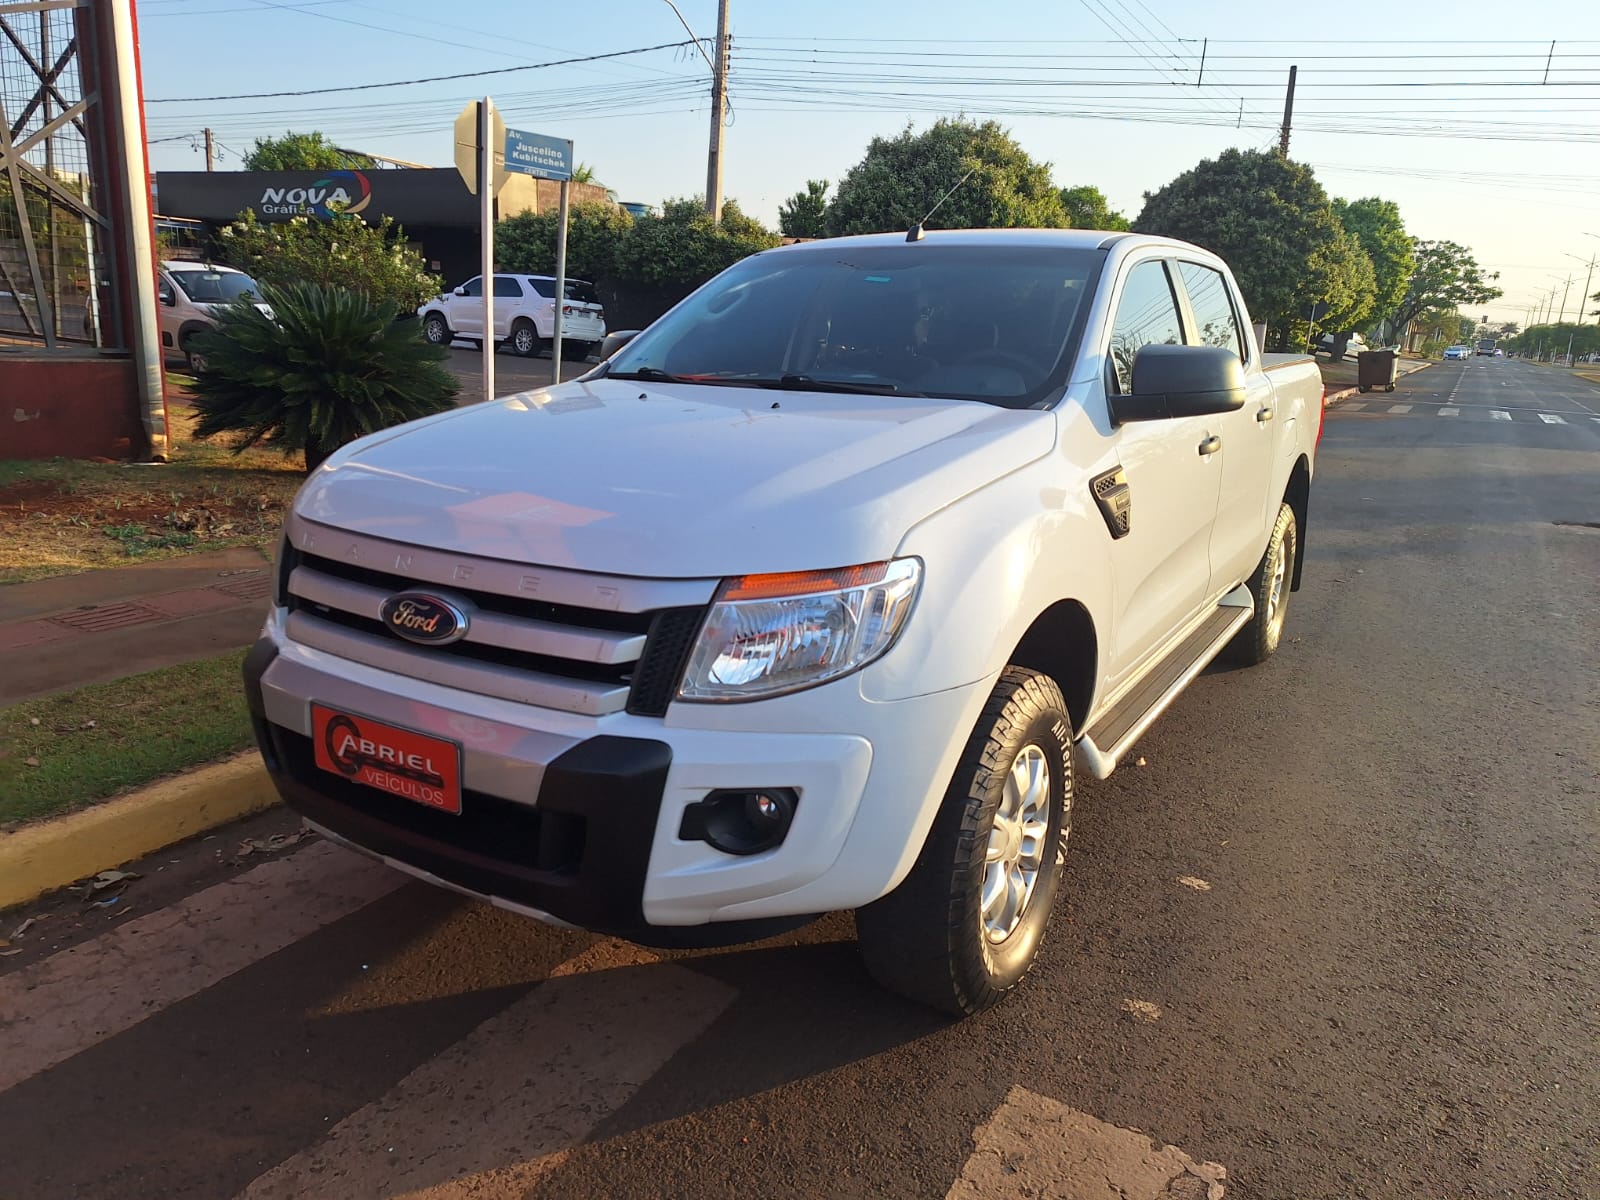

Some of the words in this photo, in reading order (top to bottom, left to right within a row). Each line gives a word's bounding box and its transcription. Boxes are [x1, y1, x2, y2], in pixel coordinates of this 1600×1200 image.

[509, 130, 523, 139] Av.
[515, 142, 562, 158] Juscelino
[512, 151, 565, 168] Kubitschek
[260, 187, 351, 204] NOVA
[393, 600, 440, 633] Ford
